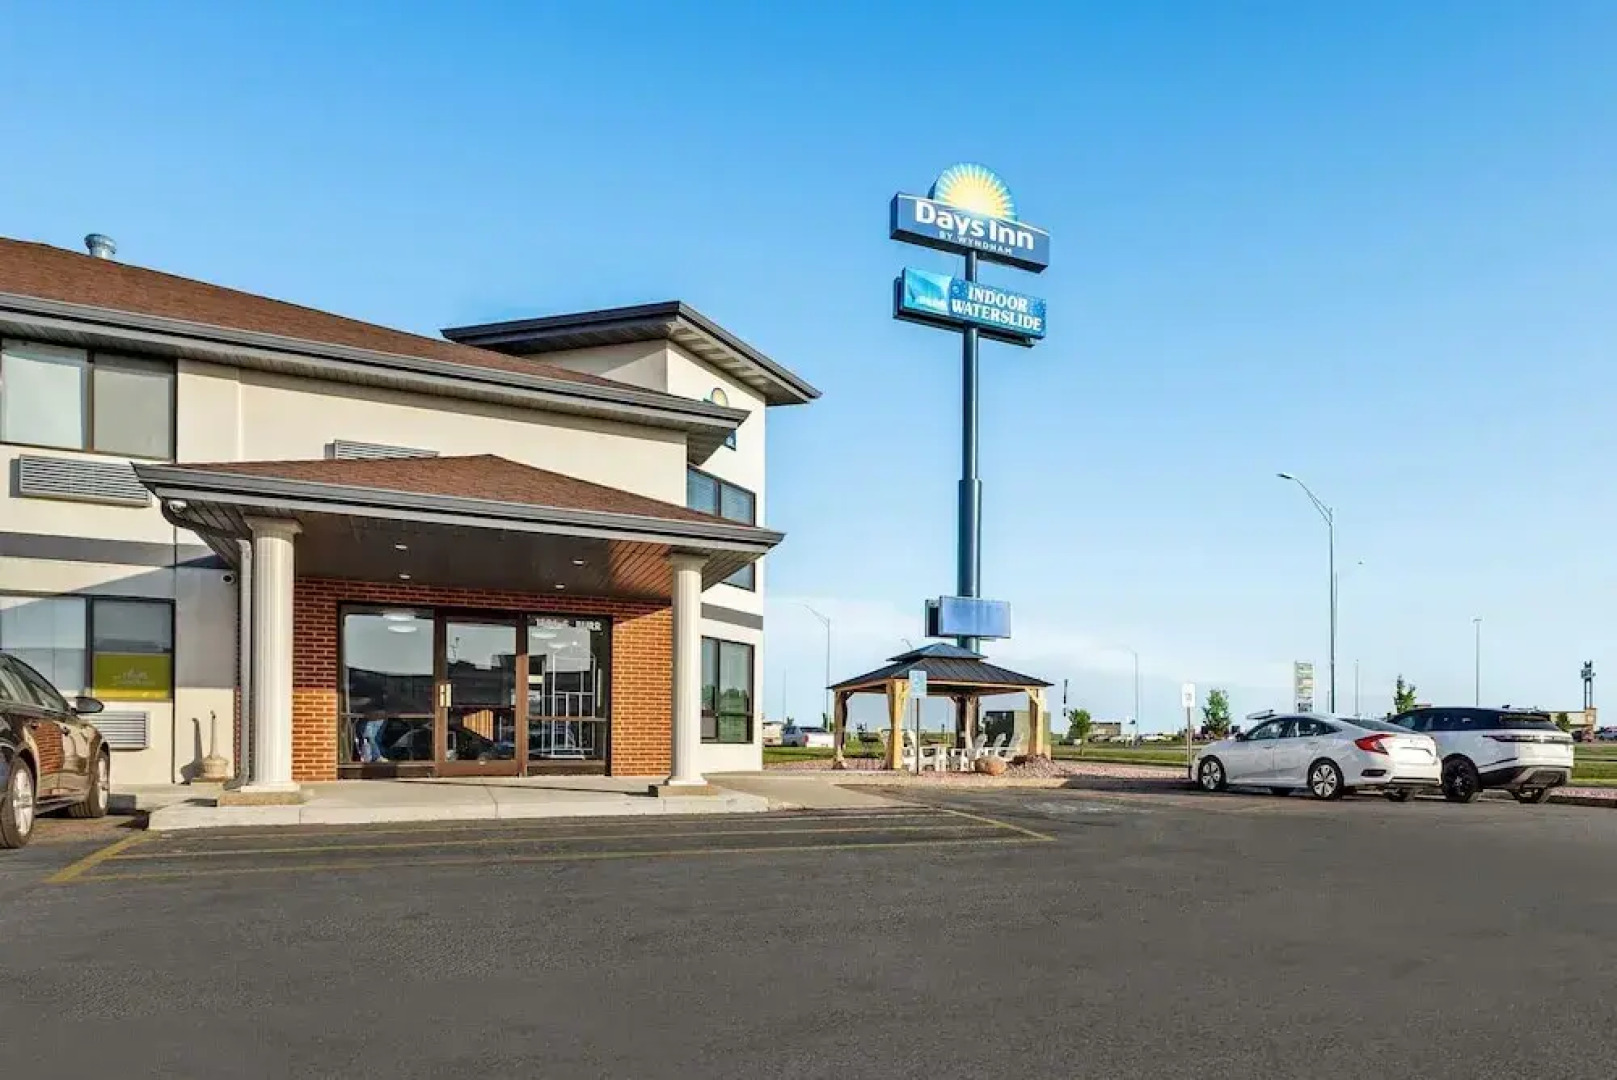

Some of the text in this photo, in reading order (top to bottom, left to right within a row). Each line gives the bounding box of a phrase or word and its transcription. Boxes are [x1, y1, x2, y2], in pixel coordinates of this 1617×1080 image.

[915, 200, 1035, 250] Days Inn
[938, 230, 1013, 255] BY WYNDHAM
[968, 285, 1028, 313] INDOOR
[951, 298, 1042, 331] WATERSLIDE
